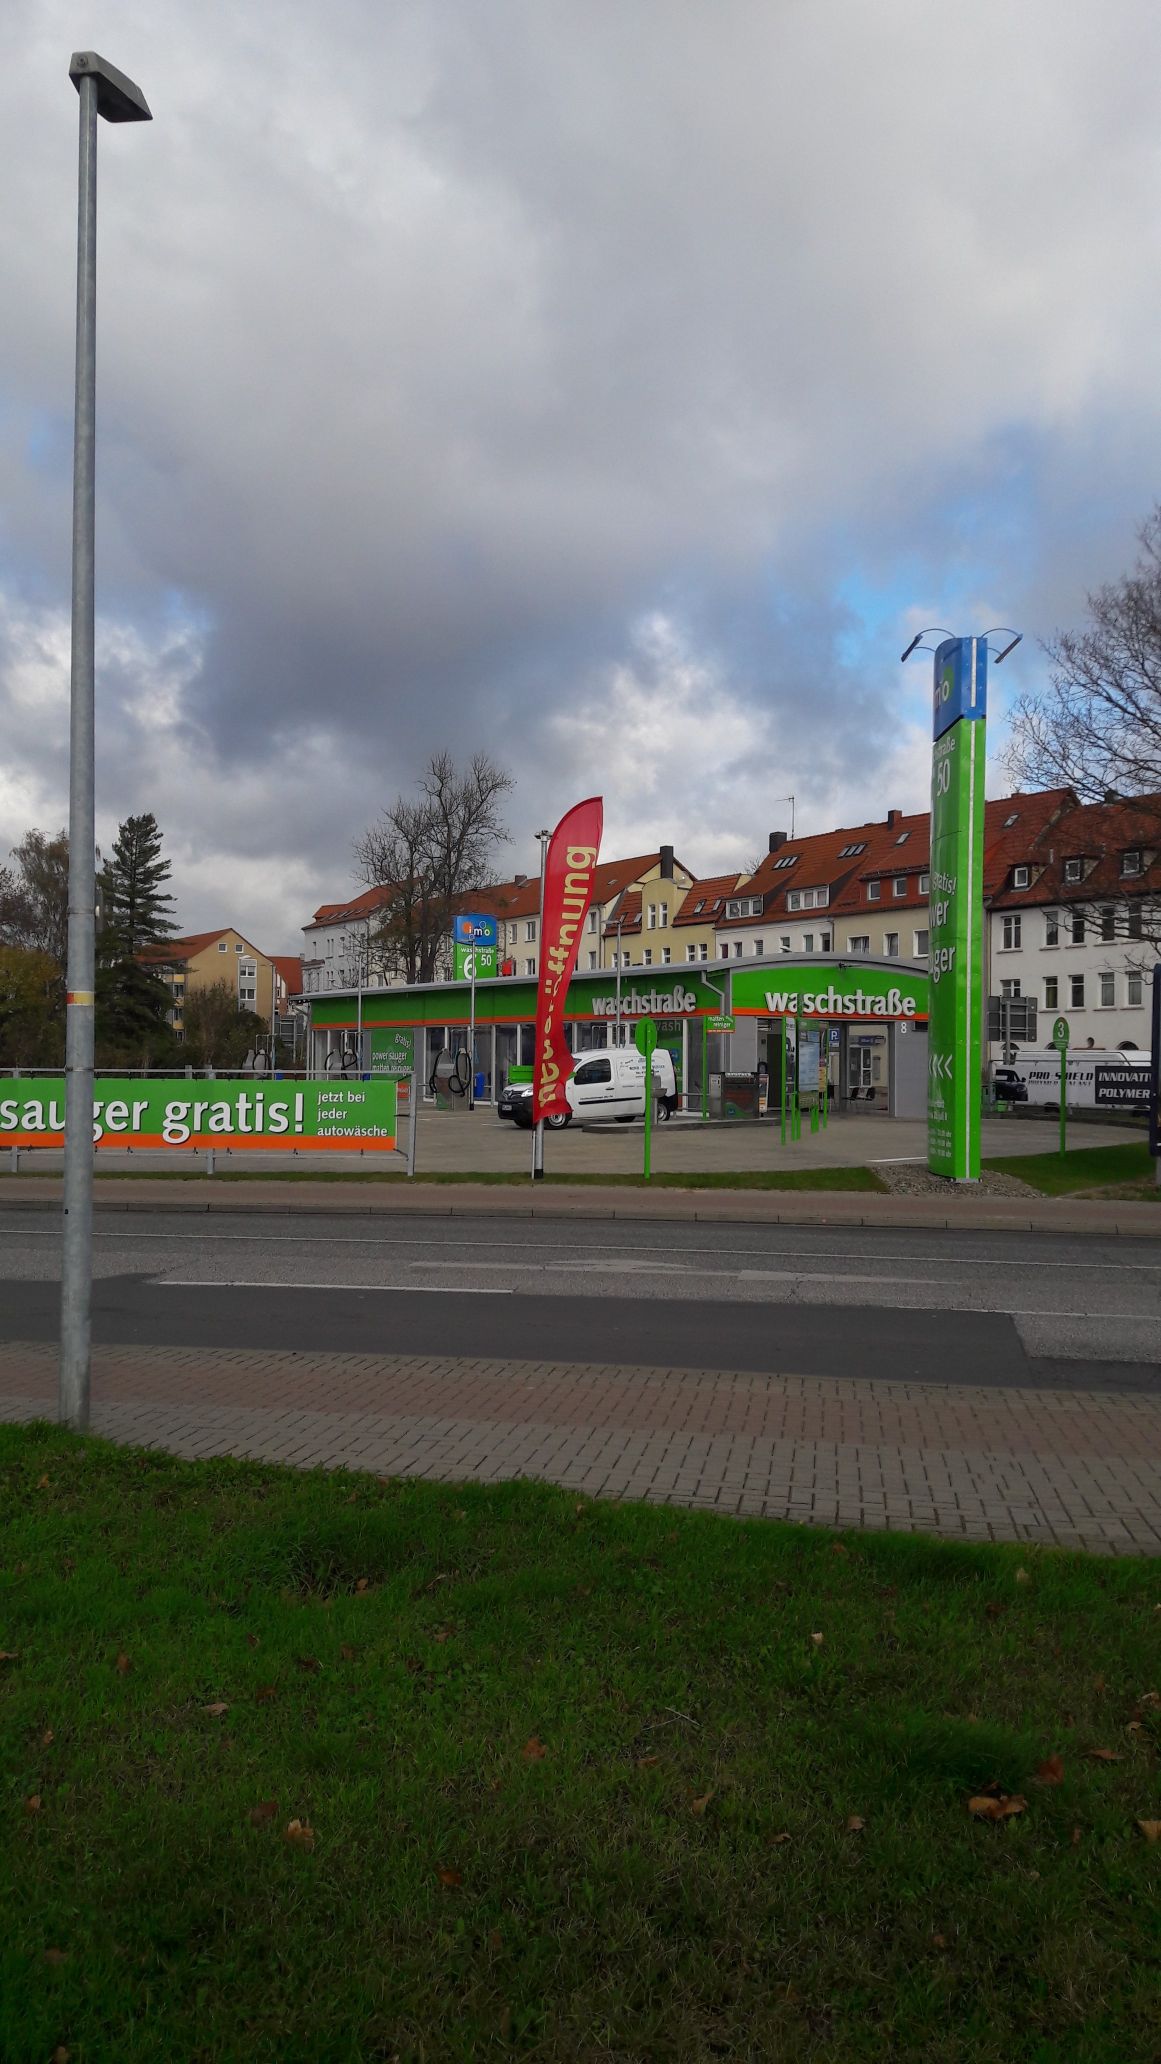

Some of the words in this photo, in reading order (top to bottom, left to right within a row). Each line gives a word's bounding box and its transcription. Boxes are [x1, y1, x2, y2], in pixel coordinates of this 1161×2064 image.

[468, 925, 491, 936] imo
[481, 954, 492, 966] 50
[592, 985, 697, 1016] waschstraße
[764, 985, 917, 1017] waschstraße
[900, 1022, 907, 1033] 8
[1057, 1021, 1065, 1038] 3
[831, 1032, 838, 1041] P
[1099, 1072, 1152, 1082] INNOVATI
[317, 1091, 344, 1105] jetzt
[347, 1090, 366, 1102] bei
[1098, 1088, 1150, 1098] POLYMER
[162, 1093, 304, 1145] gratis!
[317, 1107, 347, 1122] jeder
[317, 1125, 388, 1137] autowäsche
